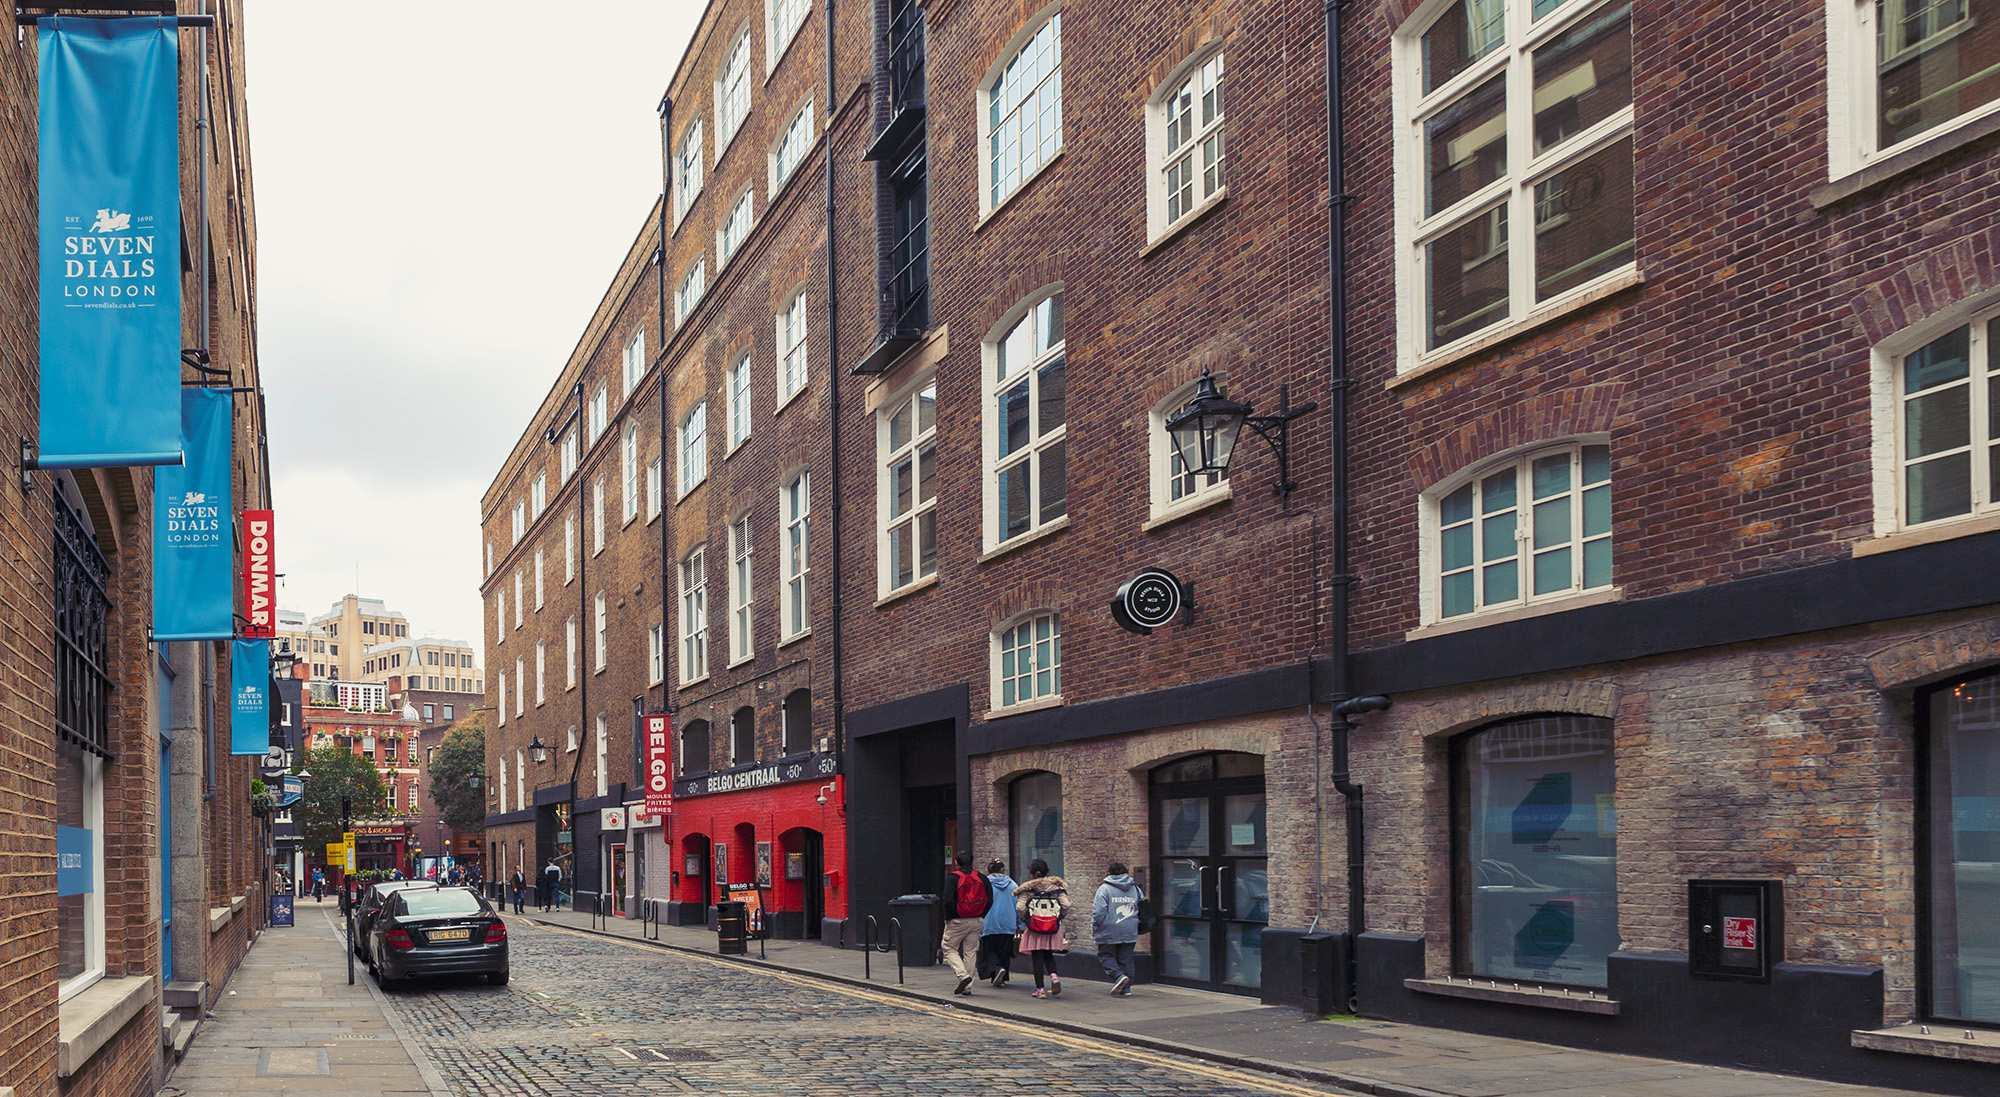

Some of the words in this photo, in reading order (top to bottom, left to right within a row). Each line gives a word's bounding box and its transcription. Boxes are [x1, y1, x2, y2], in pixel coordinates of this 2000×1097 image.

[65, 235, 154, 255] SEVEN
[65, 258, 155, 278] DIALS
[64, 285, 155, 297] LONDON
[168, 507, 218, 518] SEVEN
[168, 519, 219, 531] DIALS
[168, 534, 219, 542] LONDON
[250, 520, 268, 626] DONMAR
[649, 718, 667, 792] BELGO
[707, 775, 733, 792] BELGO
[734, 767, 780, 788] CENTRAAL
[1726, 919, 1740, 929] Dry
[448, 930, 467, 938] 6470
[1726, 929, 1747, 938] Riser
[1726, 938, 1743, 946] Inlet
